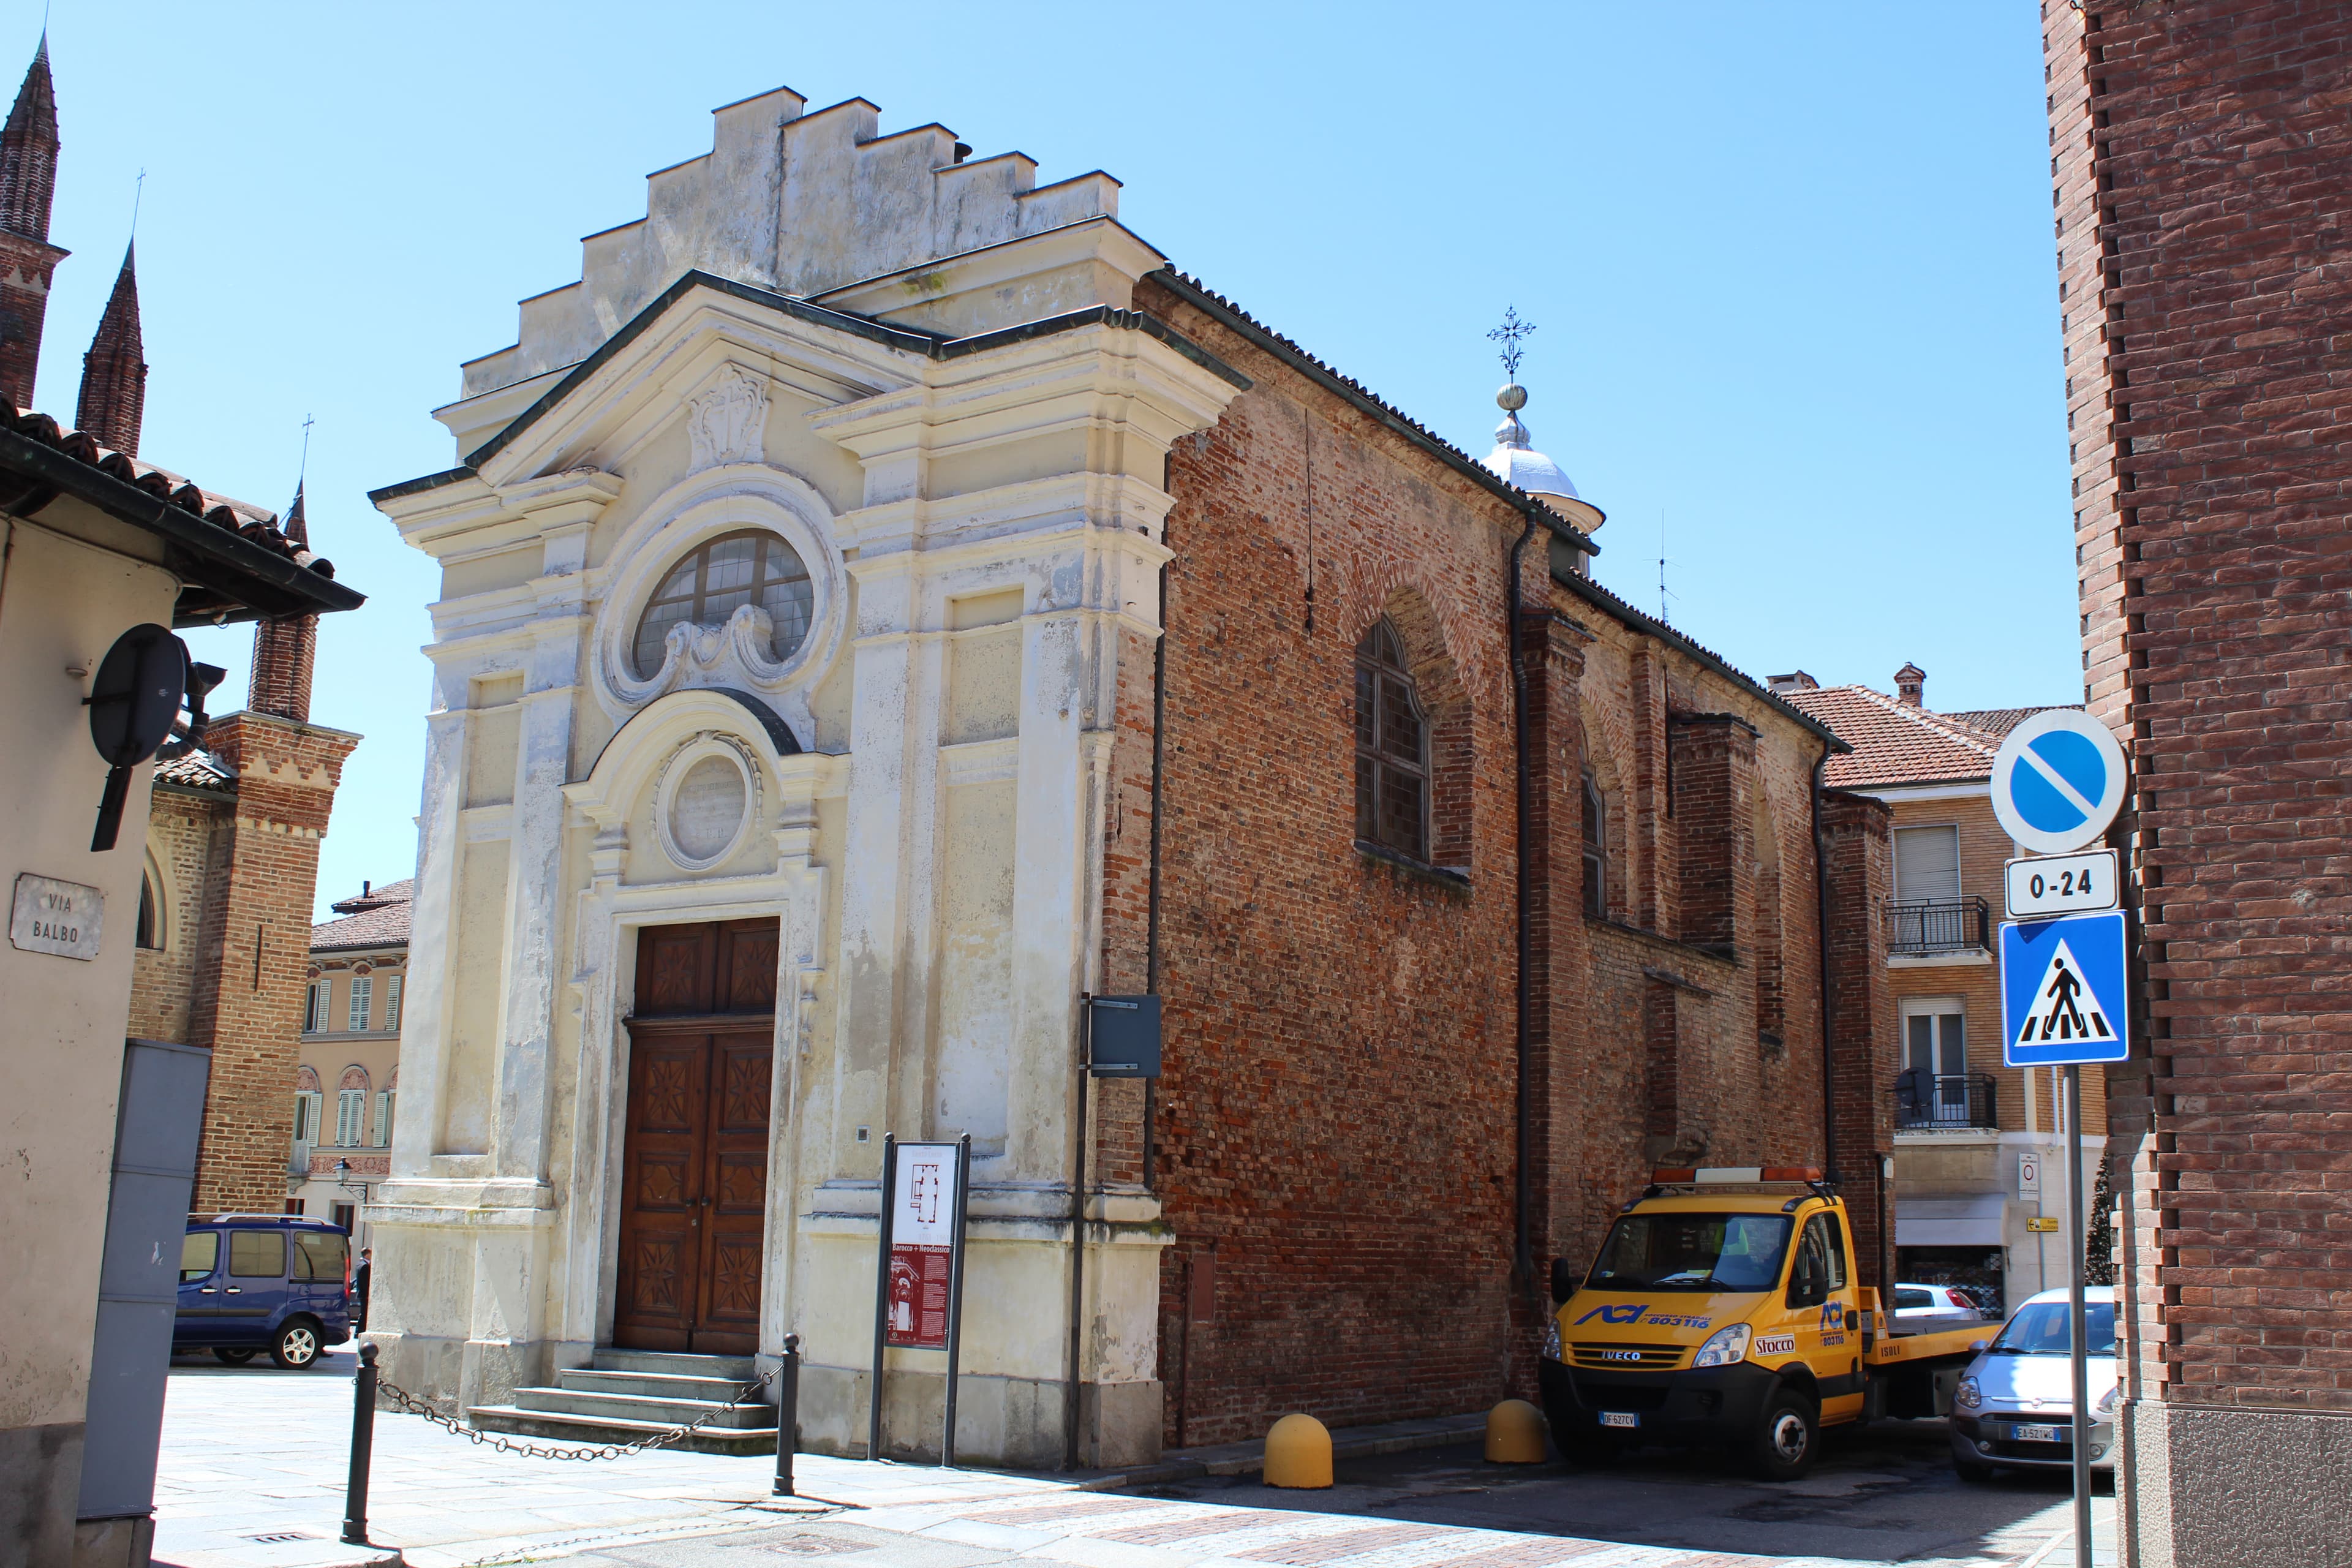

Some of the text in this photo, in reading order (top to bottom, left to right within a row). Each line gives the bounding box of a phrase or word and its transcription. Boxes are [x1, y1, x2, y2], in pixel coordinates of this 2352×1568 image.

[2030, 869, 2092, 899] 0-24
[49, 893, 72, 913] VIA
[34, 921, 78, 943] BALBO
[919, 1244, 950, 1253] Neoclassico
[1573, 1304, 1650, 1325] ACI
[1755, 1340, 1795, 1354] Stocco
[1881, 1345, 1900, 1357] ISOLI
[1601, 1351, 1641, 1361] IVECO
